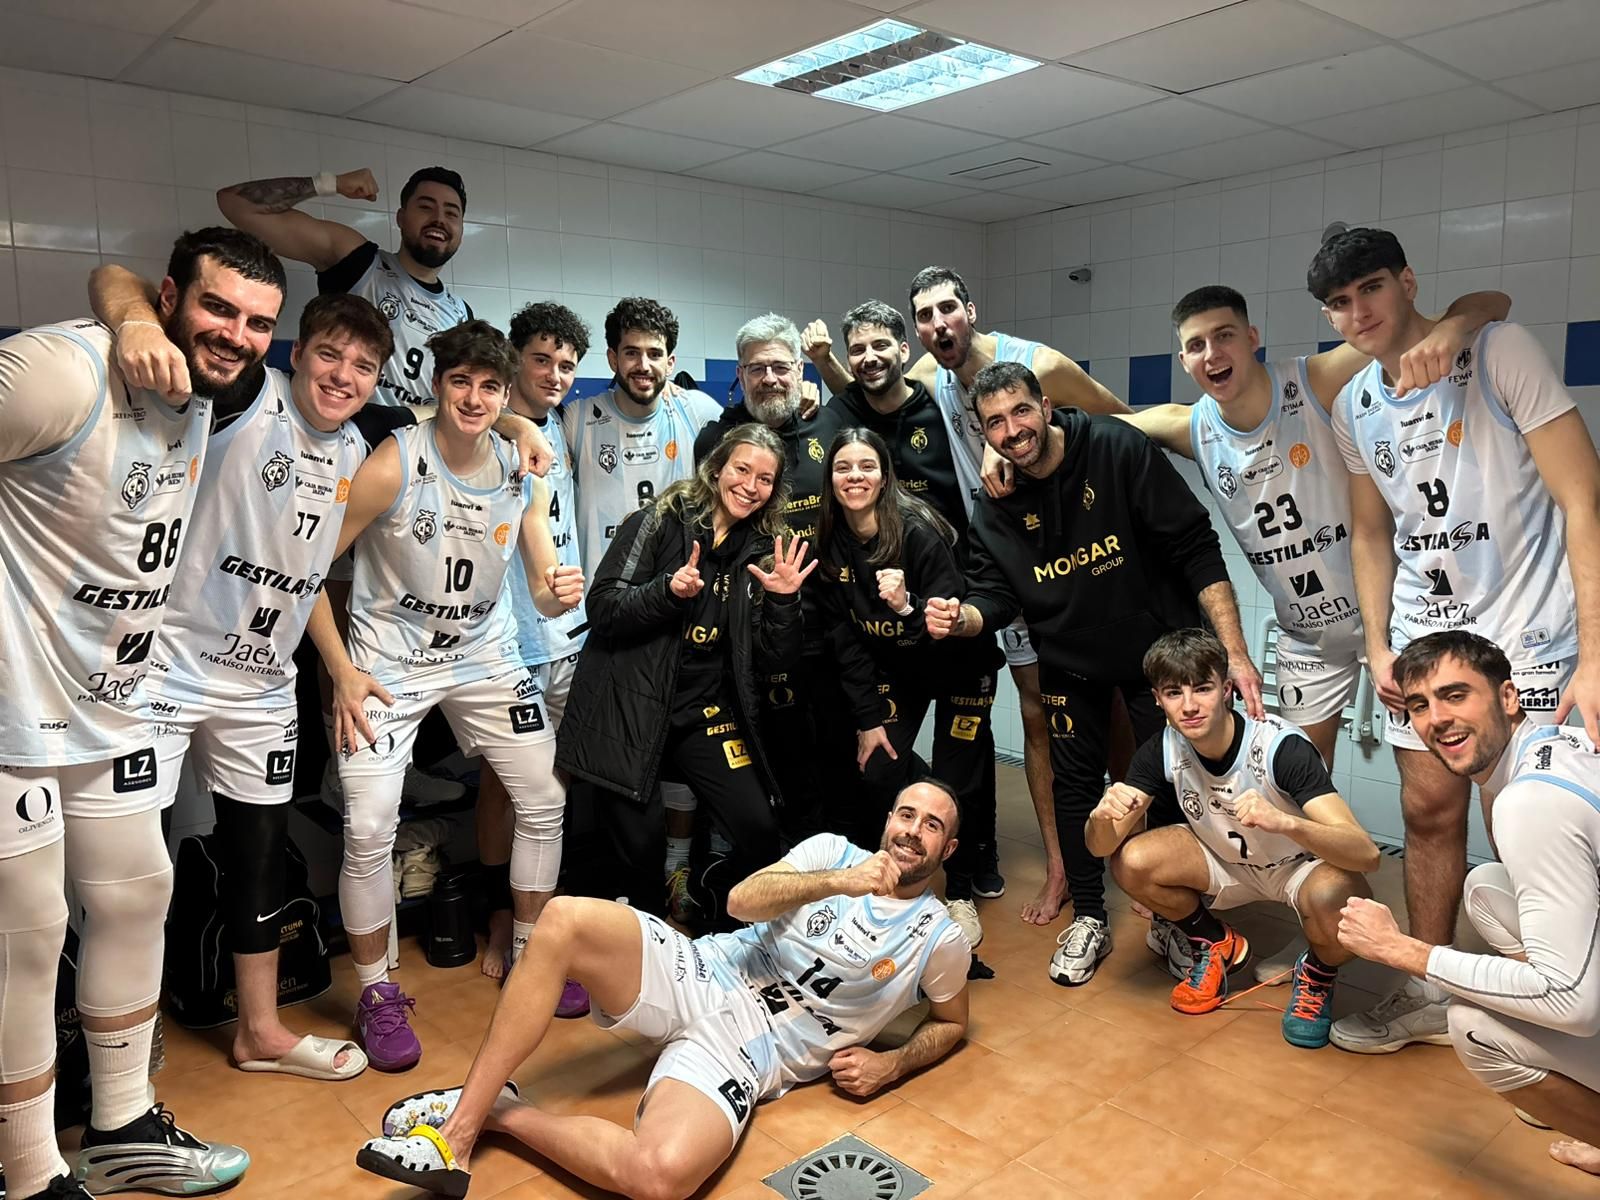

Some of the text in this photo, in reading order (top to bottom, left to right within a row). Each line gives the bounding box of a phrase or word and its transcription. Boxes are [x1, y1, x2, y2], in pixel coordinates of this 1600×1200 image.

[403, 347, 424, 380] 9
[549, 490, 560, 522] 4
[1254, 493, 1302, 538] 23
[138, 518, 182, 573] 88
[1033, 534, 1121, 583] MONGAR
[445, 556, 474, 593] 10
[1091, 556, 1125, 576] GROUP
[1290, 596, 1350, 623] Jaén
[199, 650, 243, 671] PARAÍSO
[515, 708, 538, 724] LZ
[273, 755, 291, 774] LZ
[729, 743, 747, 759] LZ
[123, 755, 152, 779] LZ
[1228, 831, 1248, 860] 7
[796, 957, 844, 999] 14
[728, 1085, 747, 1112] LZ
